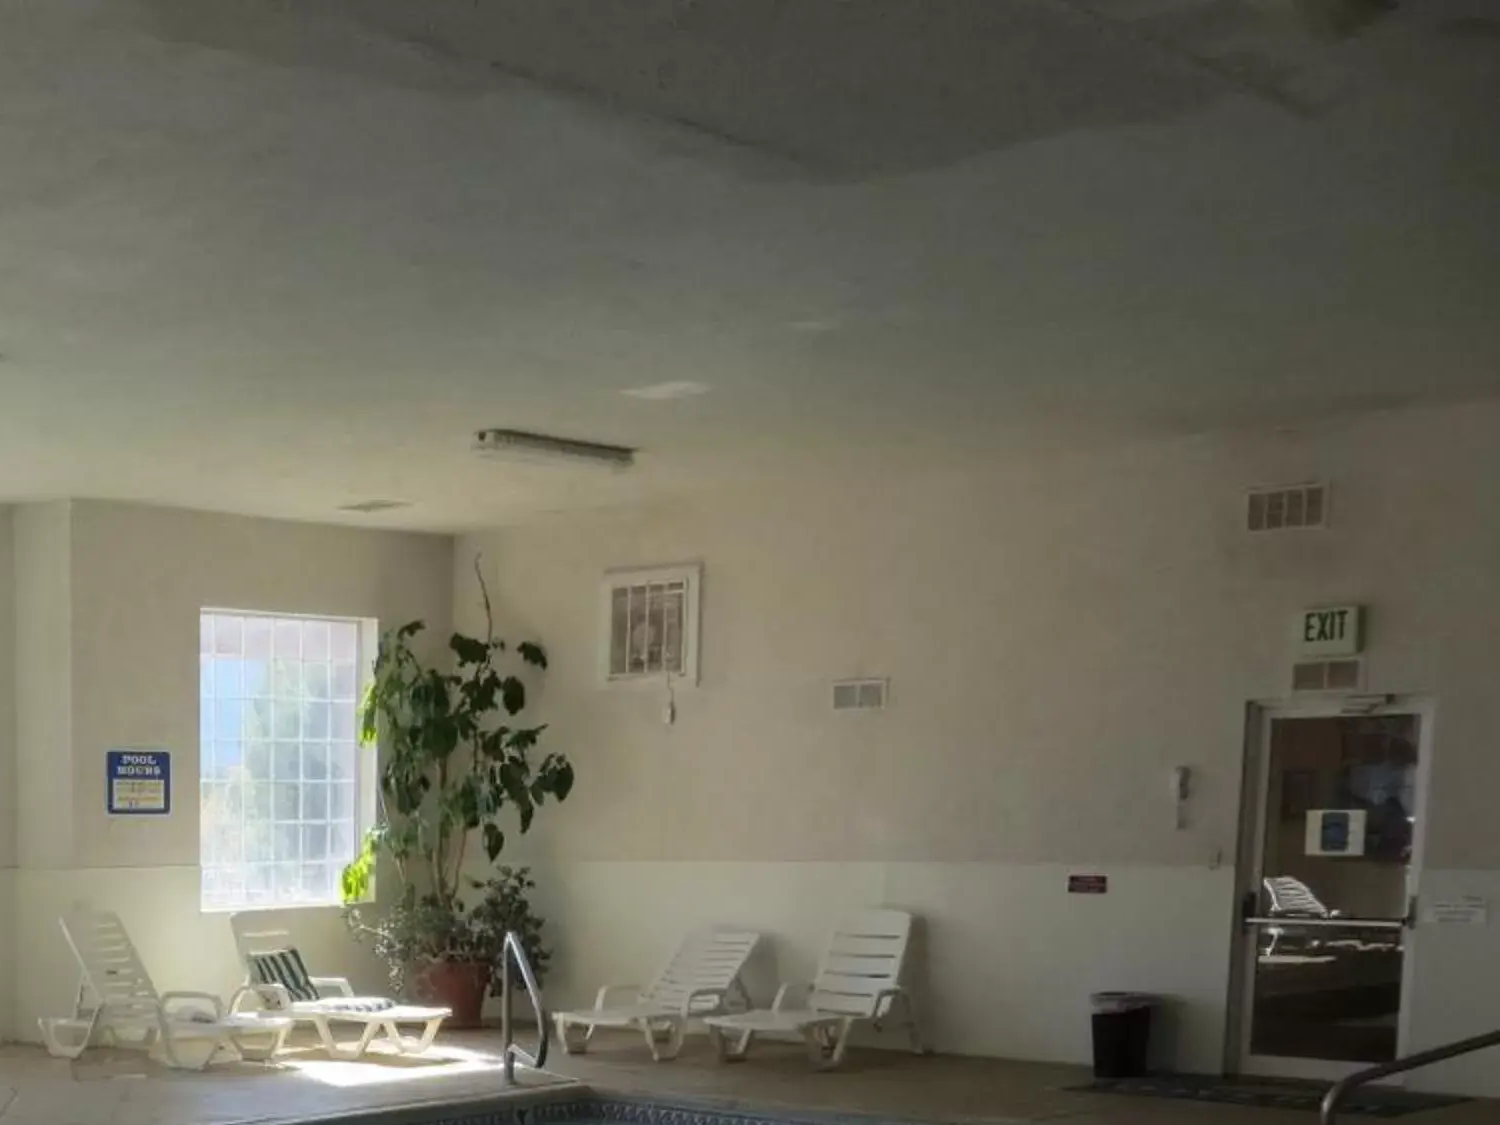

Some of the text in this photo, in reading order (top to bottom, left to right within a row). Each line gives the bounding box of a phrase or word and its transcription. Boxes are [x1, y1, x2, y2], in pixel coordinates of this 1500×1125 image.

[1304, 609, 1348, 642] EXIT
[121, 754, 157, 765] POOL
[116, 765, 161, 777] HOURS
